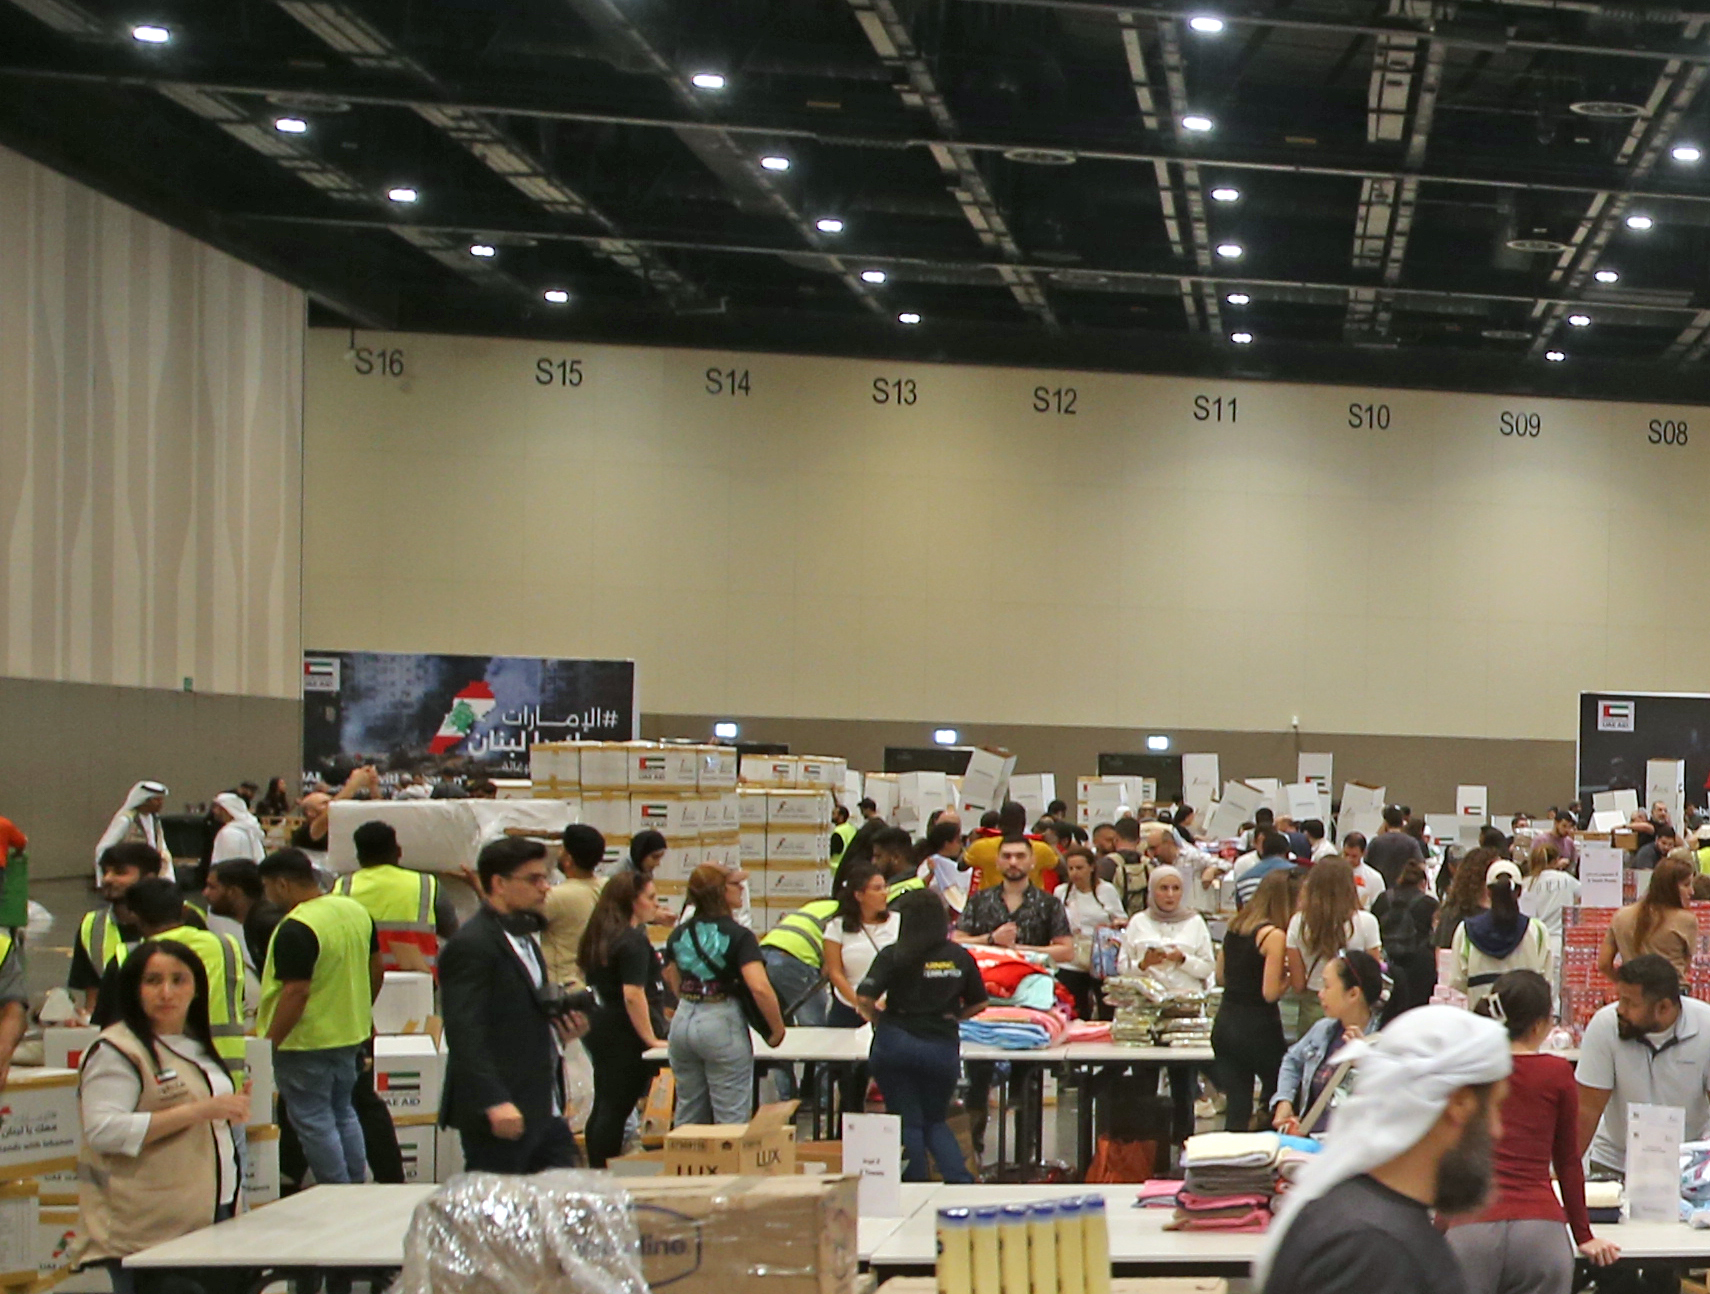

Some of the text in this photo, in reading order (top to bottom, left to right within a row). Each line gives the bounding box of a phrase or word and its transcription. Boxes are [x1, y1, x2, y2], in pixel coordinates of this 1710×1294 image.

[354, 347, 405, 378] S16
[535, 357, 584, 388] S15
[704, 367, 752, 397] S14
[872, 377, 918, 407] S13
[1032, 386, 1078, 415] S12
[1193, 395, 1239, 424] S11
[1347, 402, 1391, 431] S10
[1499, 410, 1542, 439] S09
[1647, 418, 1689, 447] S08
[401, 1098, 420, 1106] AID
[756, 1148, 781, 1167] LUX
